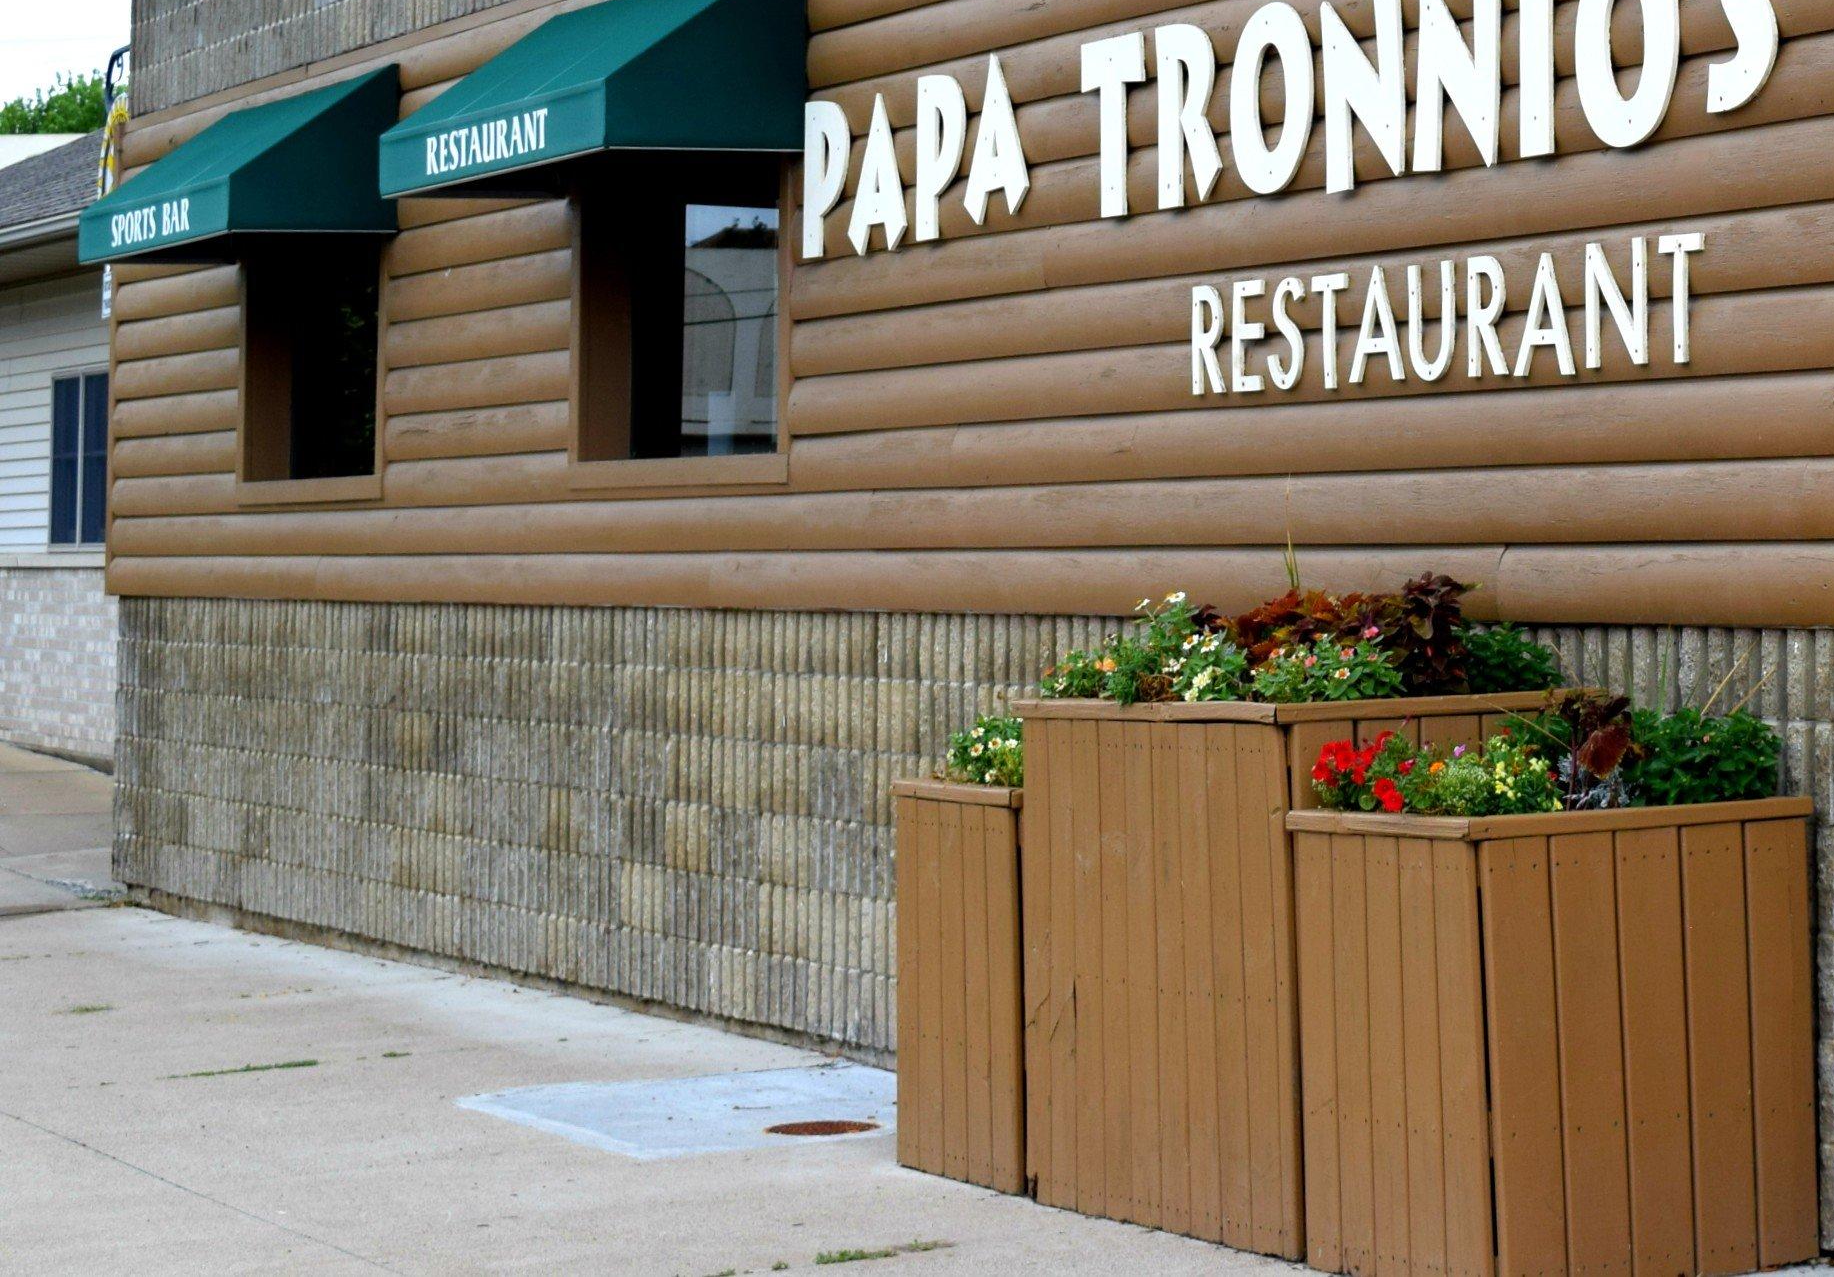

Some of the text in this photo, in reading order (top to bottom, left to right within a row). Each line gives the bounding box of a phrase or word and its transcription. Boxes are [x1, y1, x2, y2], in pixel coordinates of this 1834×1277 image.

[426, 108, 548, 175] RESTAURANT
[802, 52, 1030, 259] PAPA
[111, 198, 190, 247] SPORTS BAR
[1191, 231, 1705, 396] RESTAURANT
